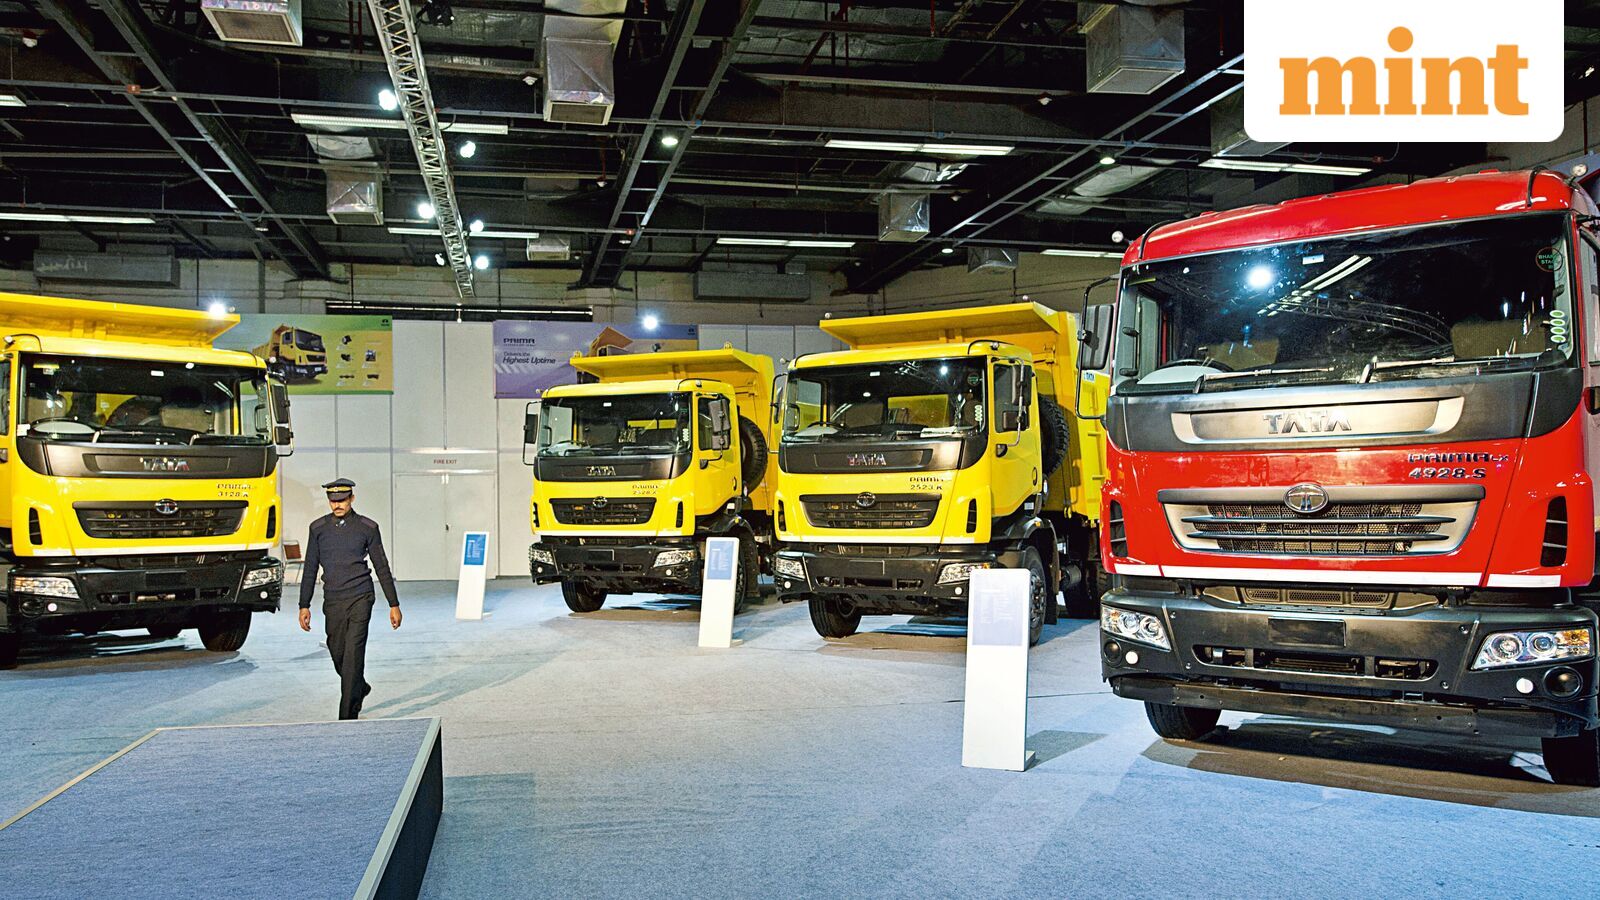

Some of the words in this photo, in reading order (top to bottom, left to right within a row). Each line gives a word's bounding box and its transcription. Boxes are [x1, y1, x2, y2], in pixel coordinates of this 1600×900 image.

[1263, 409, 1352, 434] TATA
[847, 453, 887, 466] TATA
[1408, 452, 1490, 463] PRIMA
[139, 457, 190, 471] TATA
[586, 465, 616, 476] TATA
[1408, 467, 1487, 479] 4928.S
